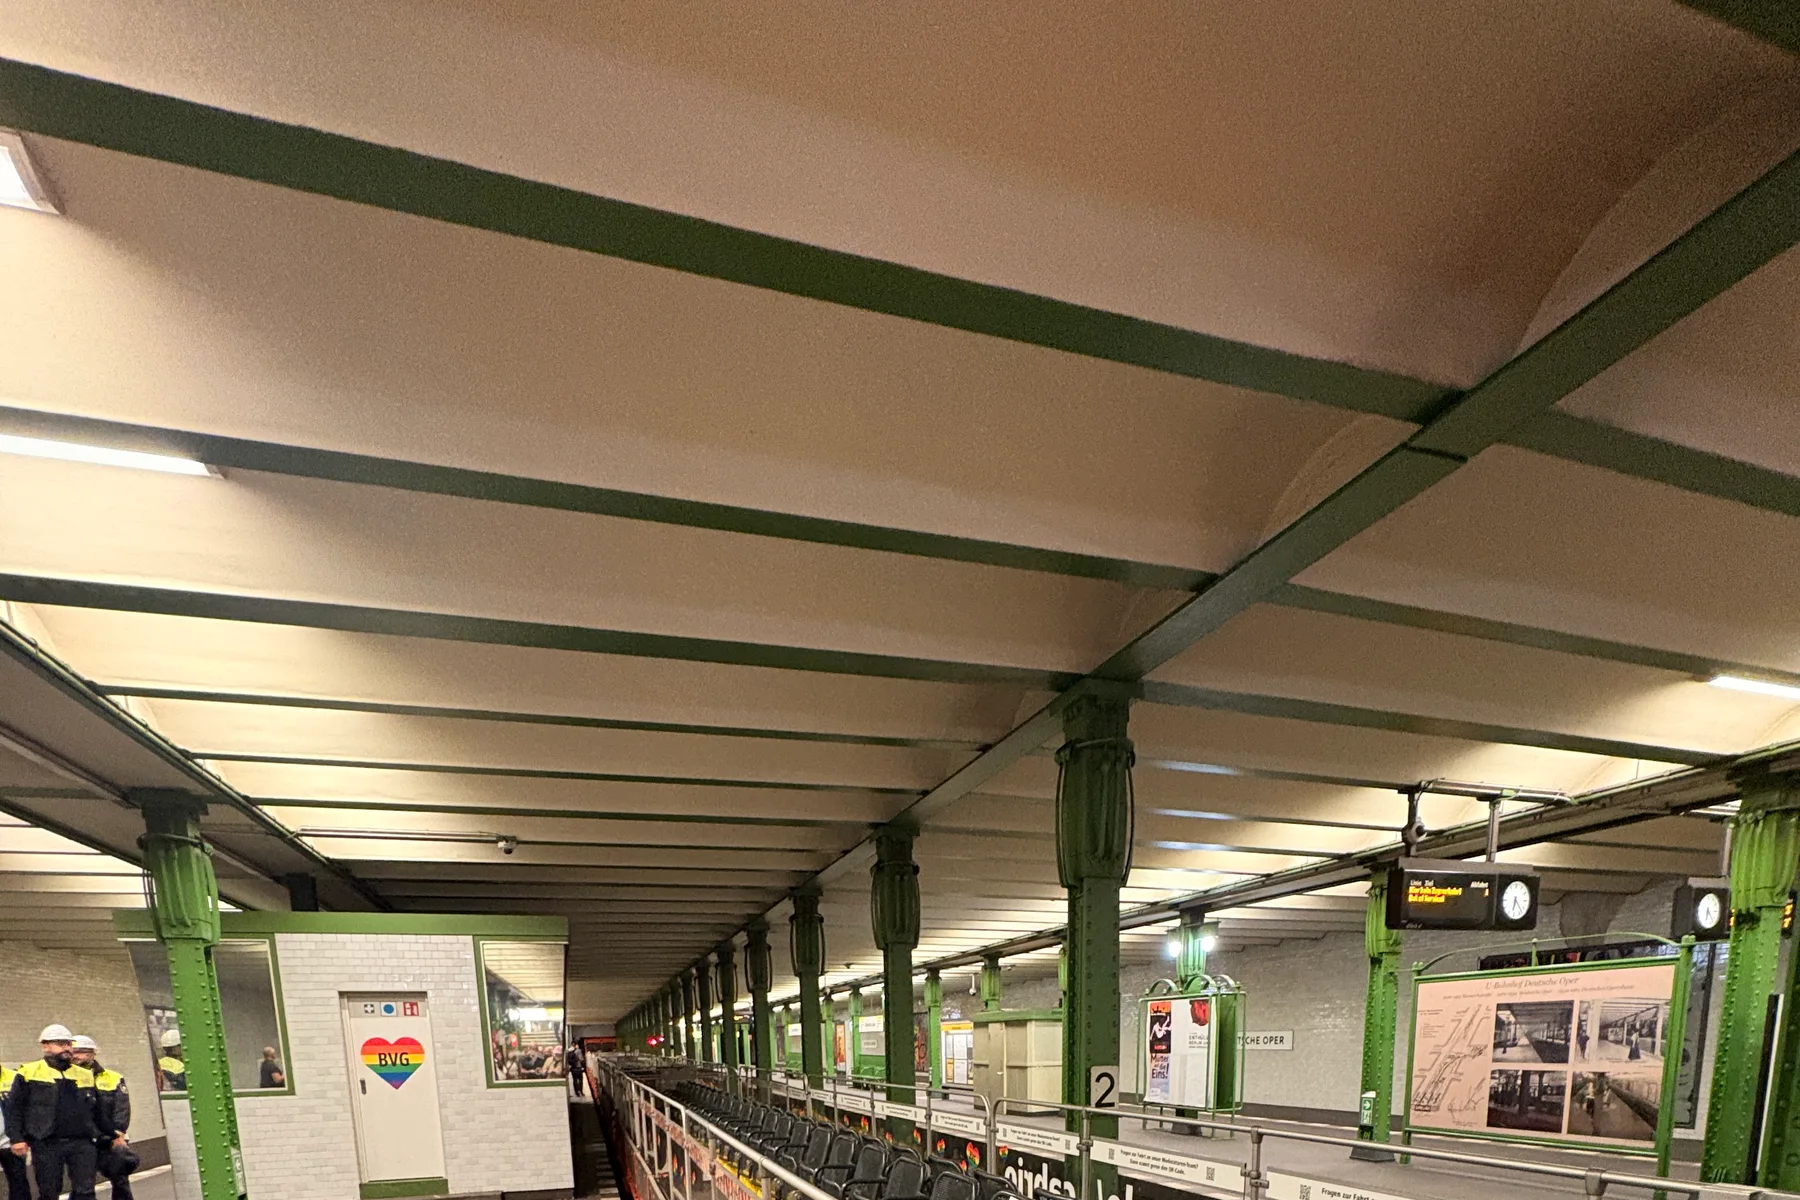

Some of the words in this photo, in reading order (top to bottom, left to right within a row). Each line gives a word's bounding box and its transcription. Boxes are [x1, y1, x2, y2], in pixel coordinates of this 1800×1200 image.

[1524, 977, 1558, 988] Deutsche
[1559, 976, 1580, 987] Oper
[1262, 1036, 1284, 1045] OPER
[378, 1052, 410, 1067] BVG
[1095, 1072, 1115, 1107] 2
[1321, 1187, 1341, 1199] Fragen
[1342, 1192, 1352, 1200] zur
